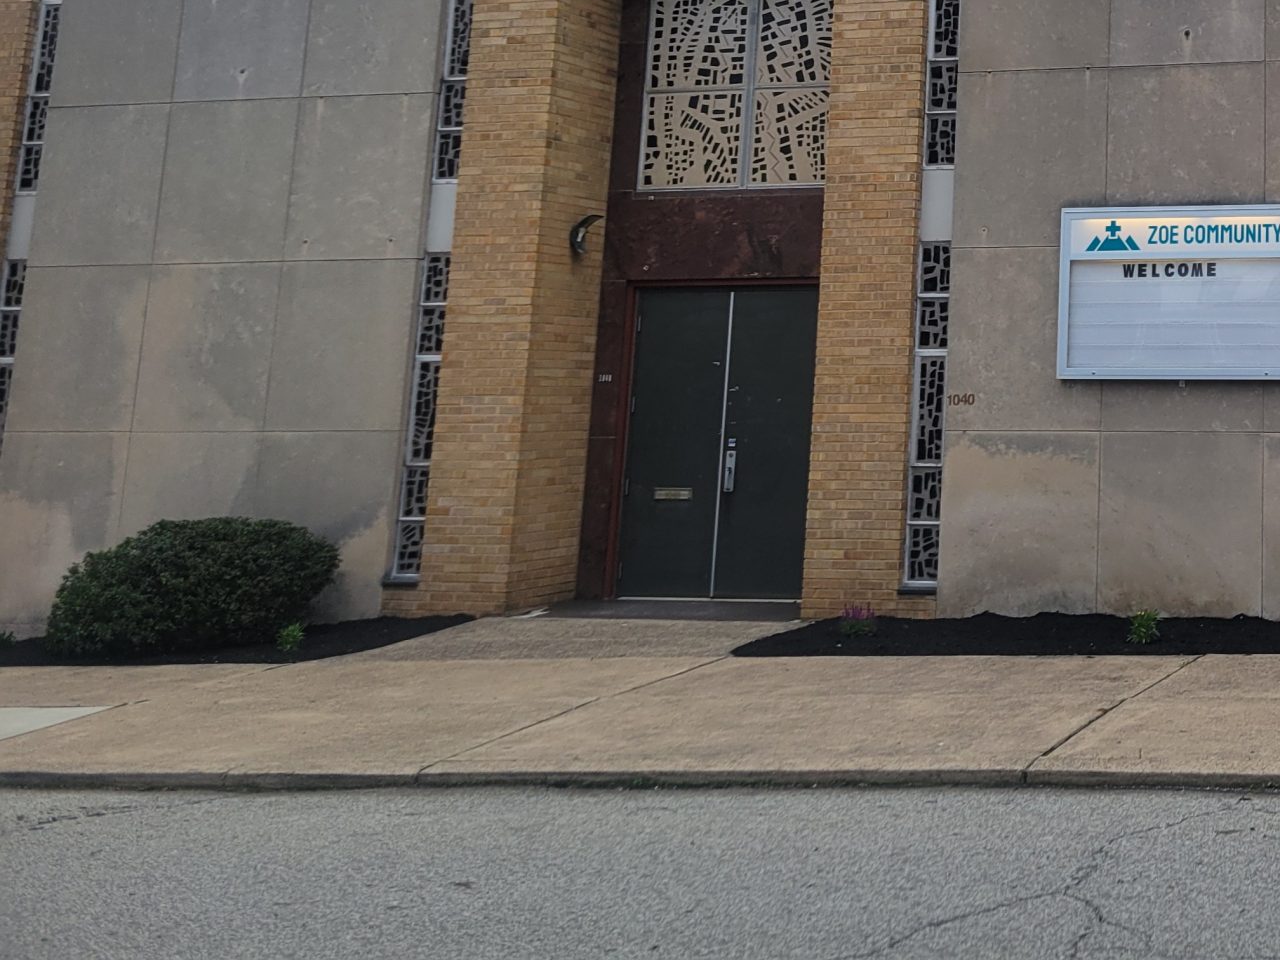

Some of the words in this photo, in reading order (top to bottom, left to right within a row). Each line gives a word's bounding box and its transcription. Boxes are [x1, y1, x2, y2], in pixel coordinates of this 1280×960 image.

[1147, 225, 1179, 245] ZOE
[1122, 262, 1217, 279] WELCOME
[947, 393, 975, 406] 1040
